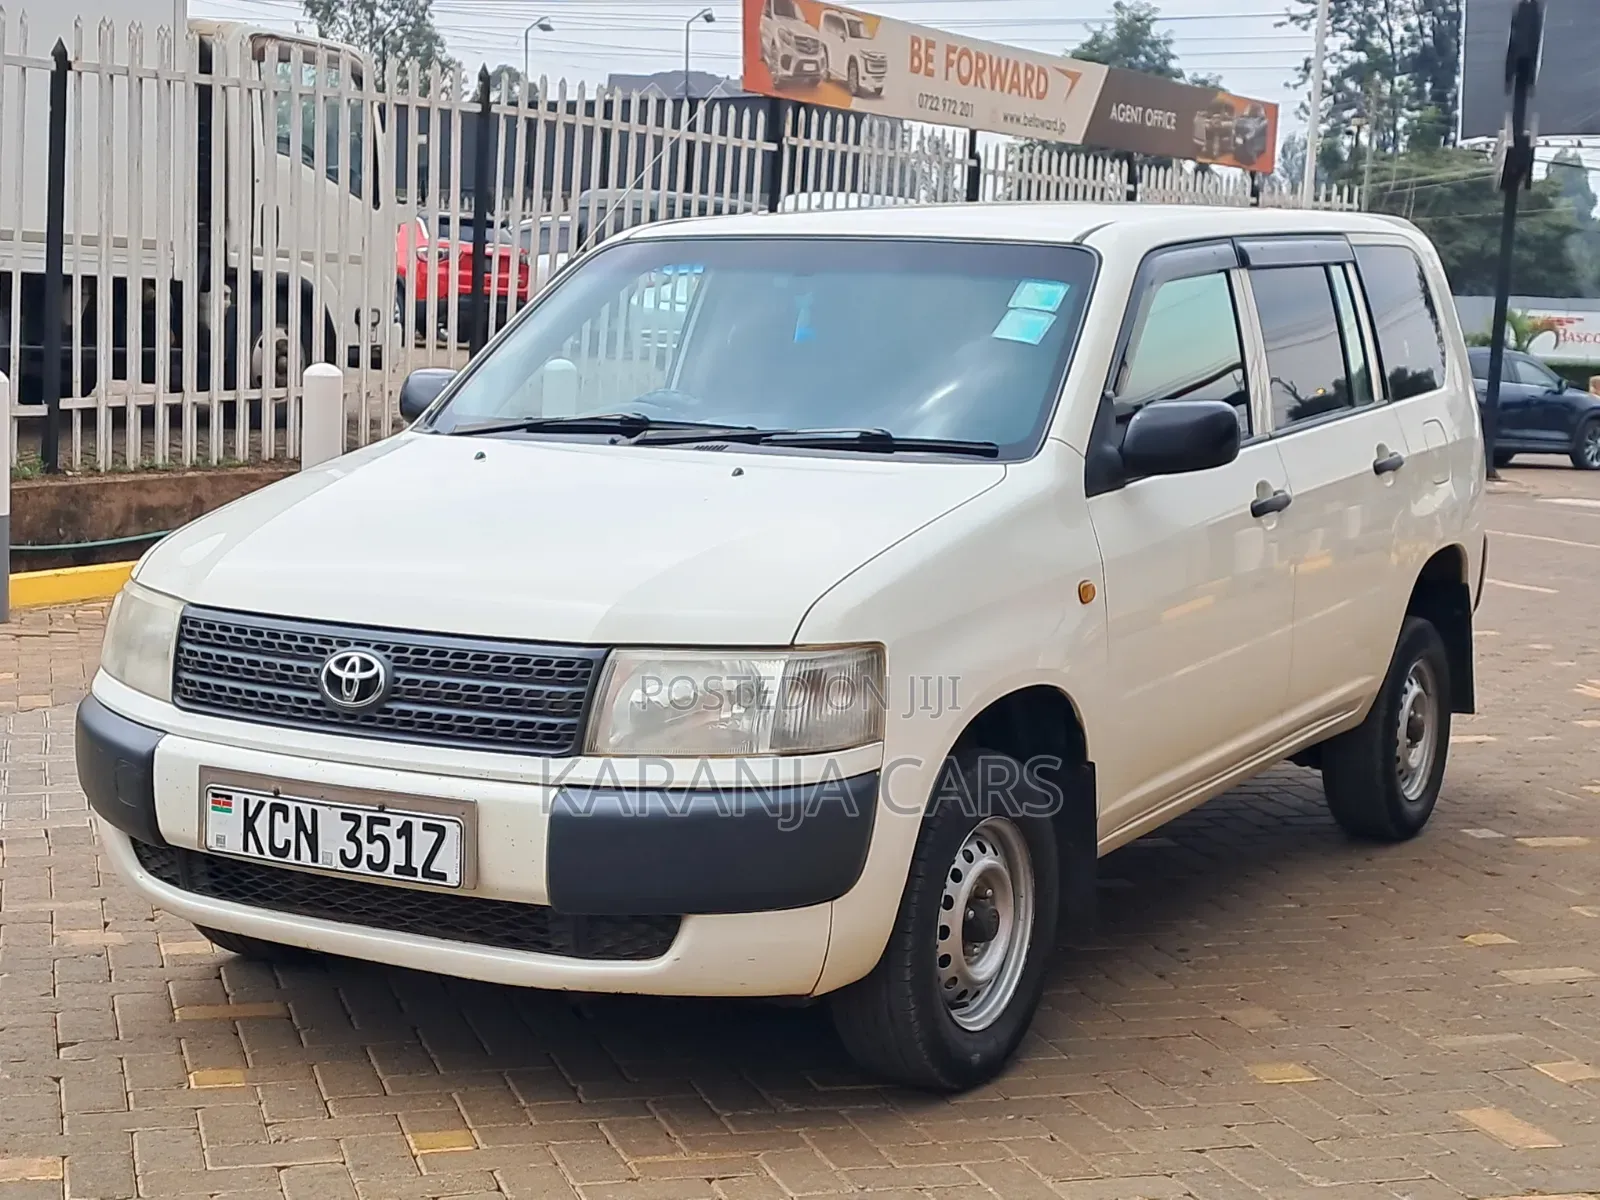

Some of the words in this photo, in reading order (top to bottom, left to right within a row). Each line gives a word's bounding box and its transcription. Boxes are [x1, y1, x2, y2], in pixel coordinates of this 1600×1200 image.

[909, 35, 937, 78] BE
[944, 43, 1049, 100] FORWARD
[917, 92, 940, 112] 0722
[942, 97, 958, 115] 972
[959, 101, 974, 118] 201
[1109, 102, 1144, 125] AGENT
[1145, 108, 1177, 130] OFFICE
[242, 797, 319, 864] KCN
[339, 812, 448, 882] 351Z
